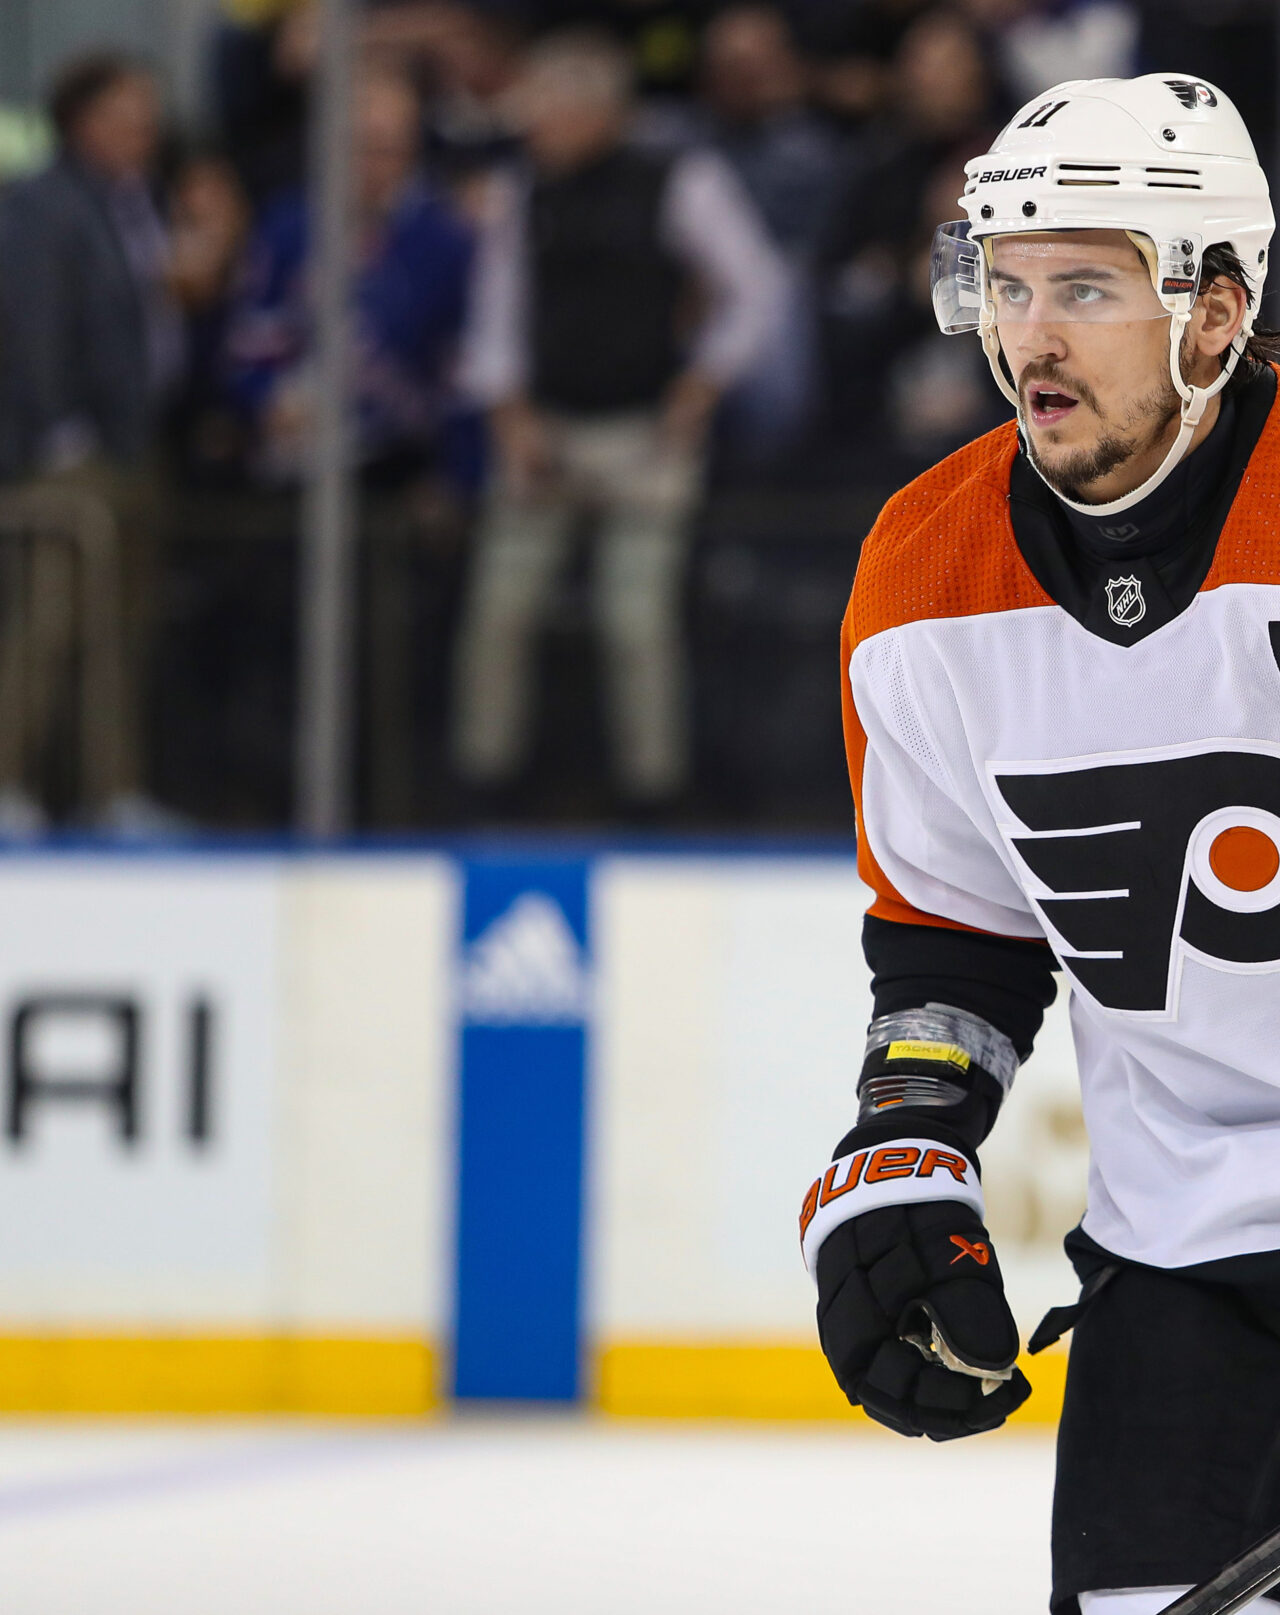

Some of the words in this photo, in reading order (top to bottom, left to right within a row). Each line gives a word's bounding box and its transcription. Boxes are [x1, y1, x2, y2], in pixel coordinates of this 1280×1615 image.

[1016, 100, 1070, 129] 11
[978, 166, 1047, 184] BAUER
[1116, 590, 1137, 617] NHL
[895, 1045, 942, 1054] TACKS
[799, 1147, 968, 1242] AUER
